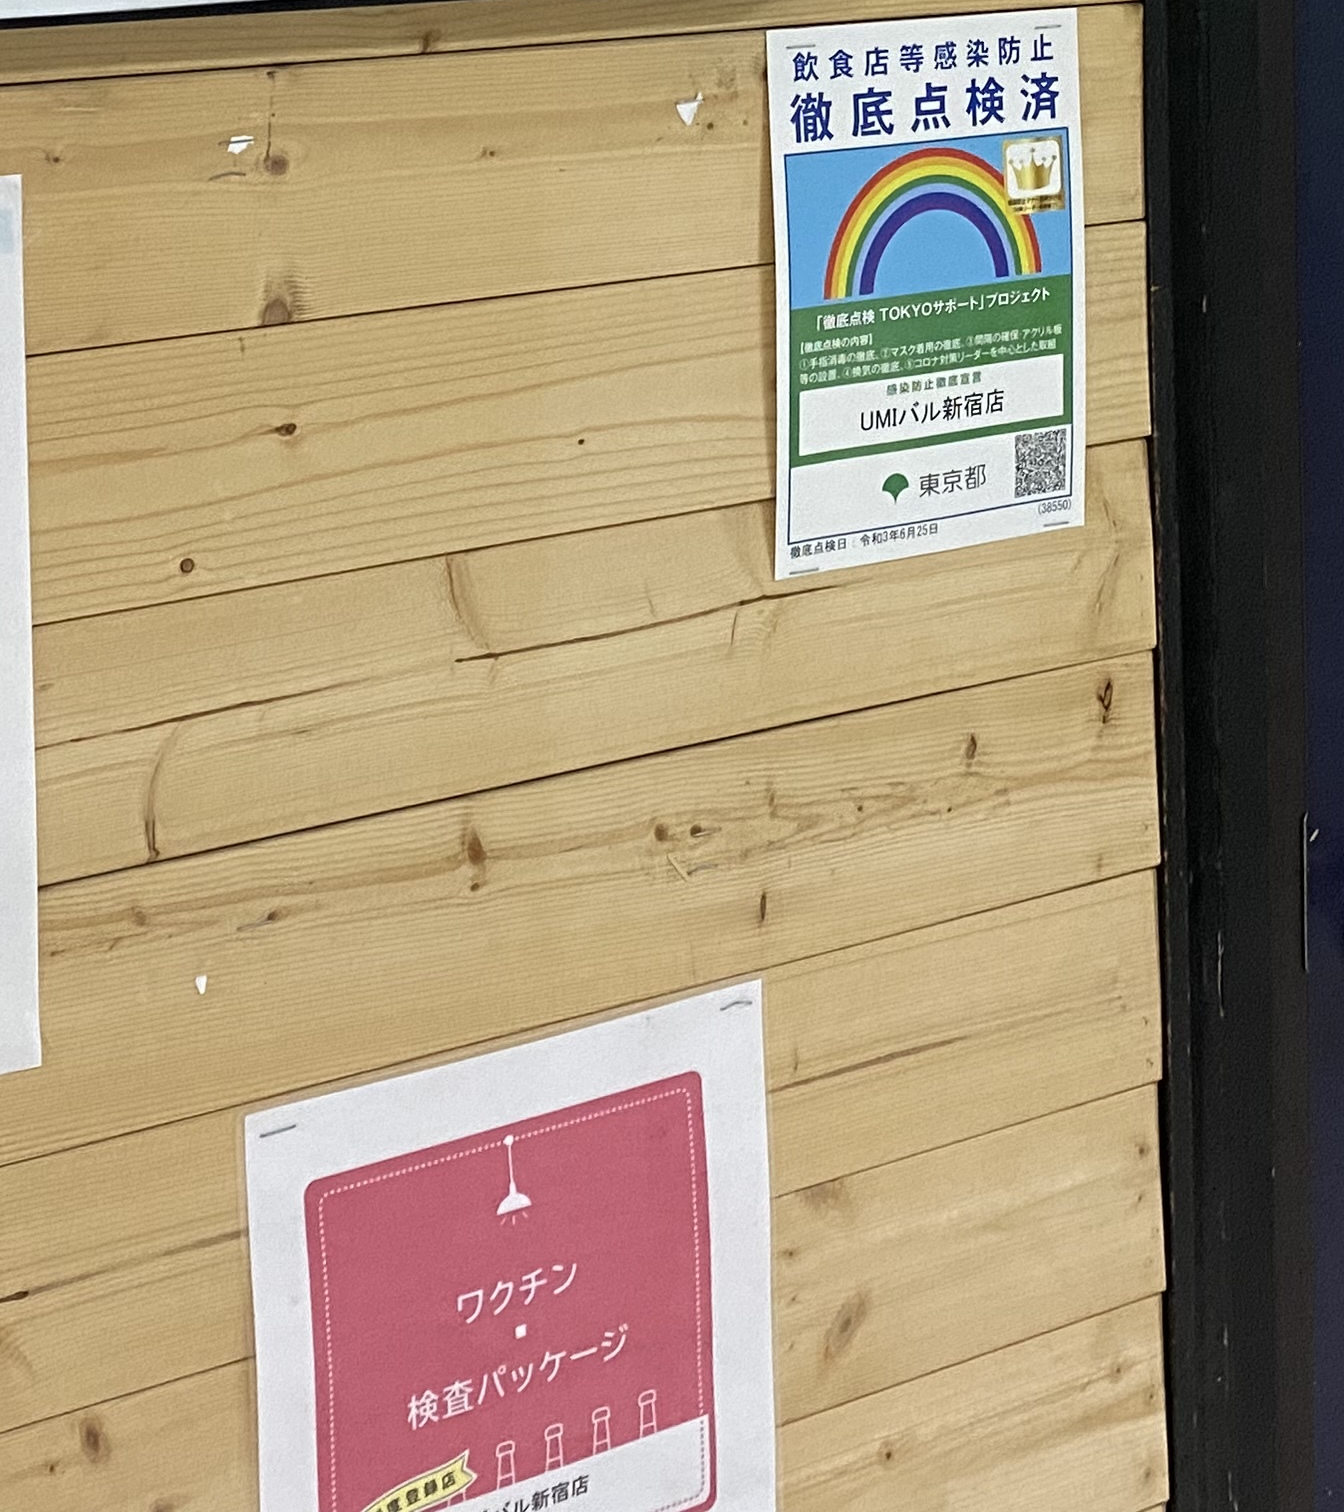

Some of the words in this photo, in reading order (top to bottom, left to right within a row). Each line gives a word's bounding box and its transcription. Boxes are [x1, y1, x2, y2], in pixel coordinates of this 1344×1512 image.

[793, 34, 1054, 82] 飲食店等感染防止
[790, 72, 1060, 144] 徹底点検済
[860, 388, 1005, 431] UMIバル新宿店
[919, 464, 987, 497] 東京都
[456, 1262, 578, 1324] ワクチン
[407, 1323, 630, 1431] 検査パッケージ
[375, 1471, 456, 1512] 度登録店
